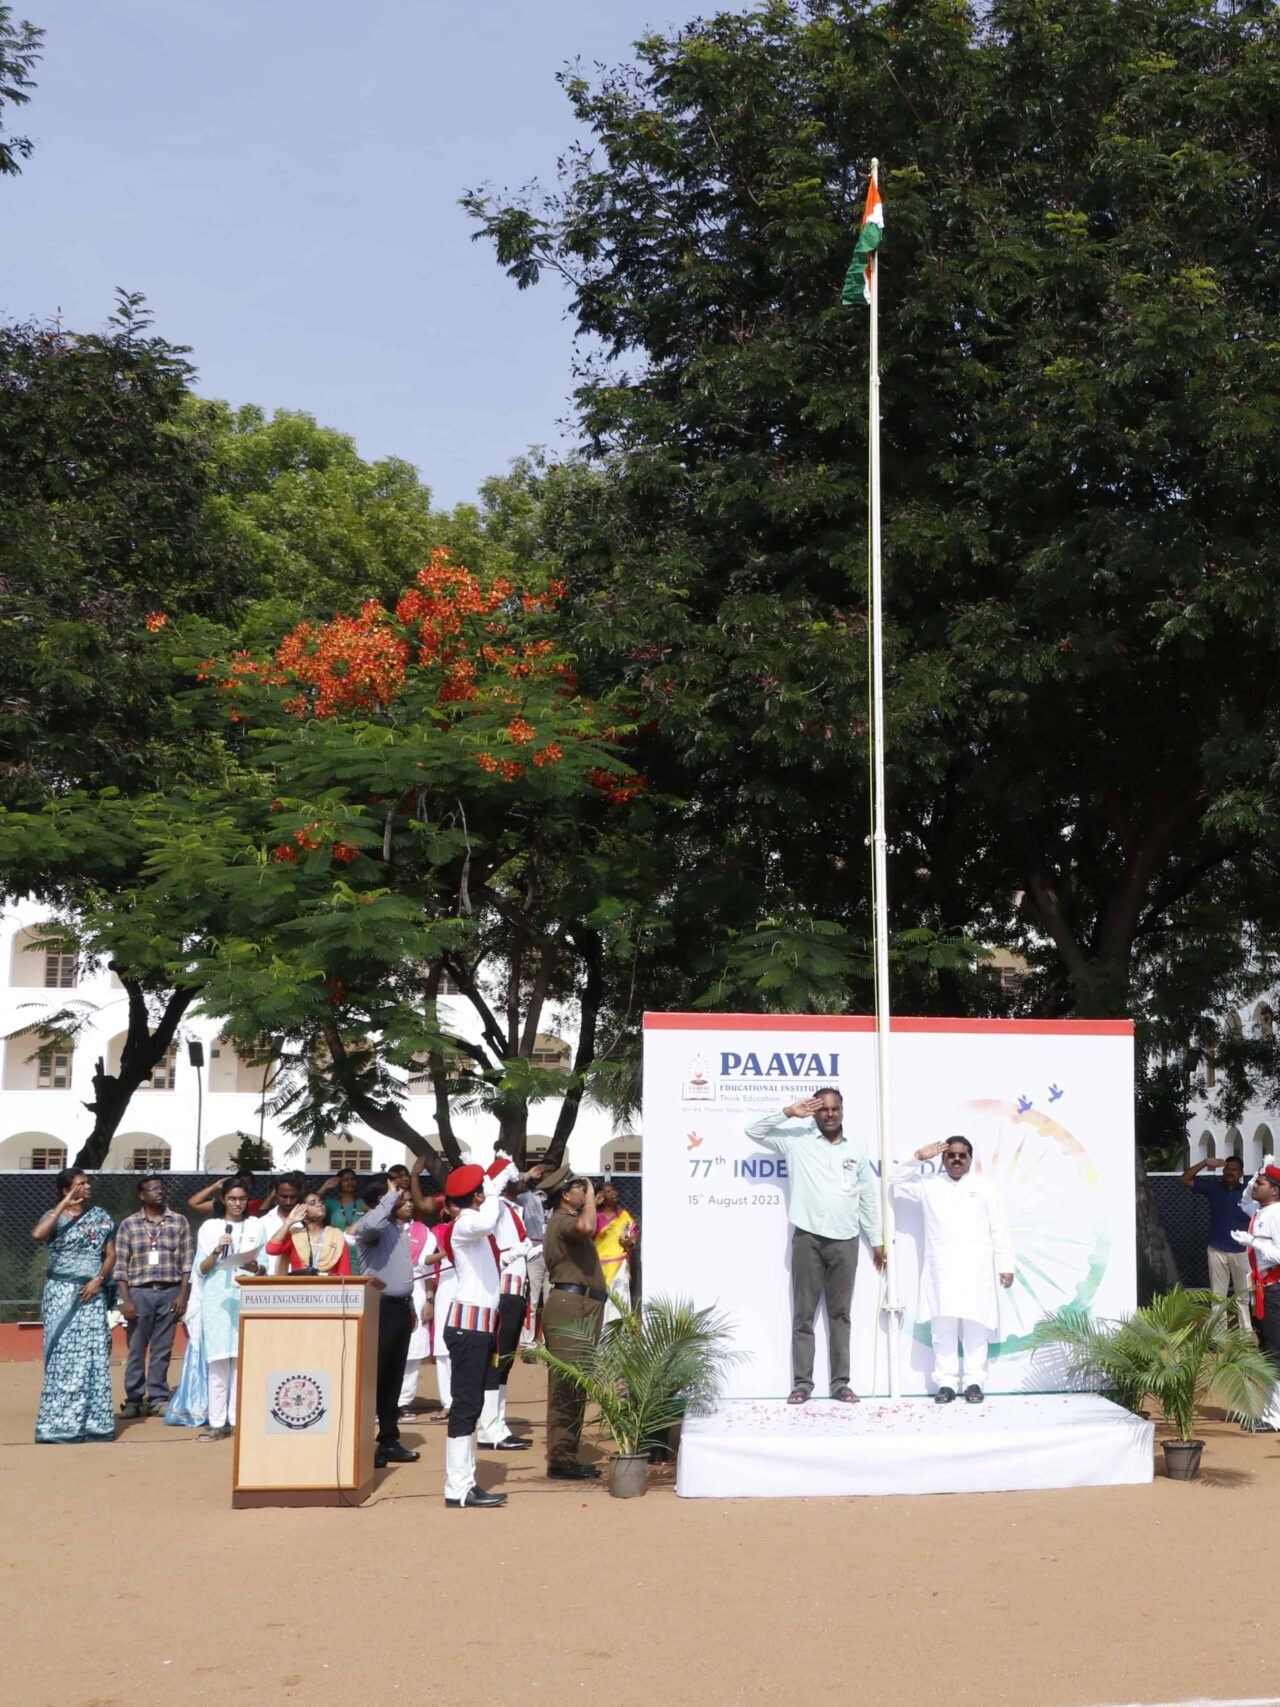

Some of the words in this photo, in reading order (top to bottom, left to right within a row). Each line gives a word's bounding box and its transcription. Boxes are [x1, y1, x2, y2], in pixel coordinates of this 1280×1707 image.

[720, 1052, 840, 1077] PAAVAI
[719, 1084, 778, 1092] EDUCATIONAL
[720, 1094, 740, 1102] Think
[743, 1094, 781, 1102] Education
[689, 1155, 726, 1178] 77th
[708, 1195, 748, 1208] August
[752, 1195, 780, 1206] 2023
[245, 1295, 271, 1304] PAAVAI
[272, 1294, 324, 1304] ENGINEERING
[325, 1294, 360, 1304] COLLEGE
